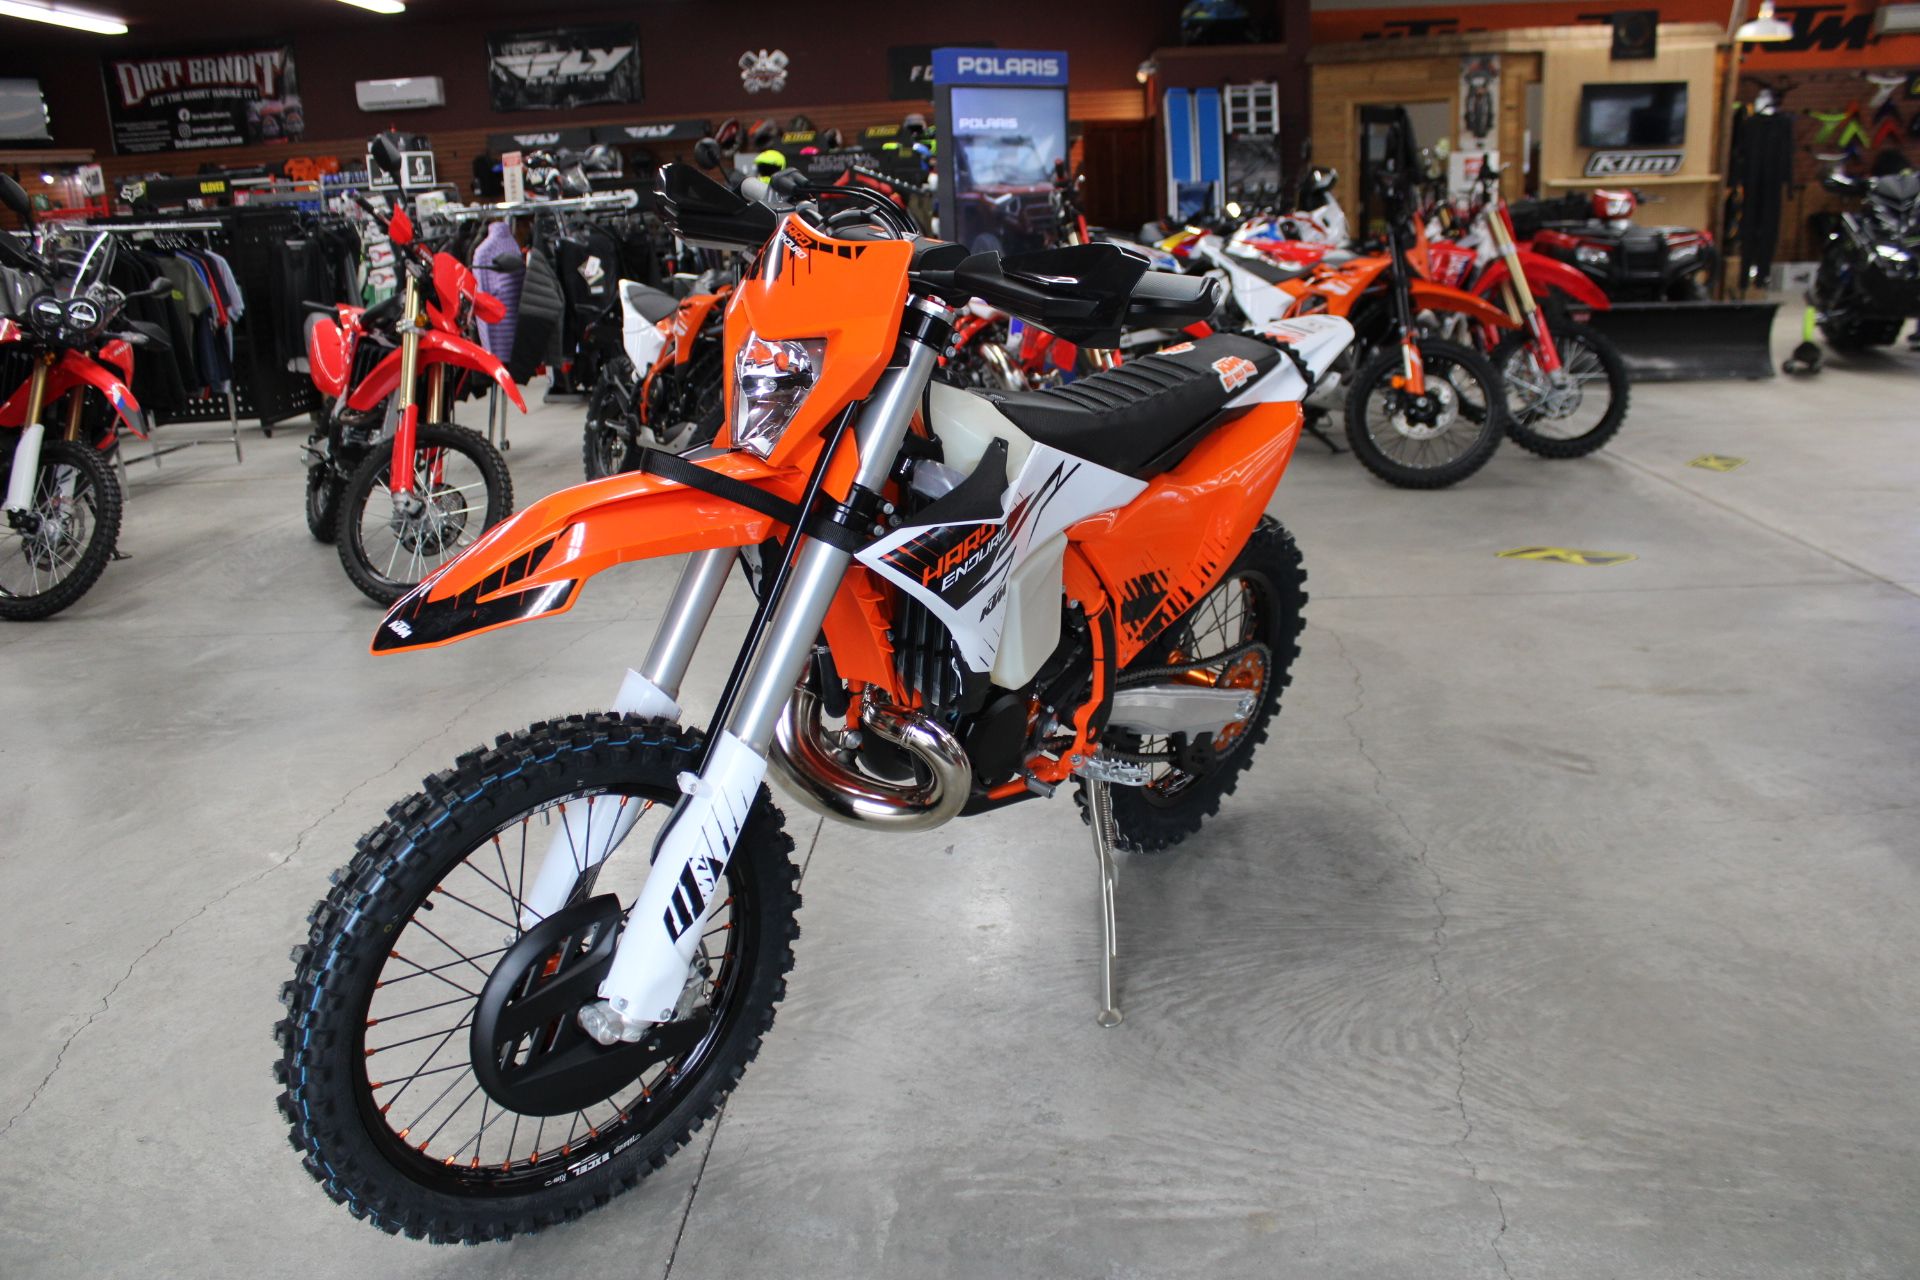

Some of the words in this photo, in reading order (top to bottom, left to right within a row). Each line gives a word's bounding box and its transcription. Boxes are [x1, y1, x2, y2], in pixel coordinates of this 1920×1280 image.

[494, 46, 633, 79] FLY
[957, 56, 1059, 76] POLARIS
[116, 60, 183, 105] DIRT
[187, 51, 282, 96] BANDIT
[624, 124, 676, 138] FLY
[959, 117, 1018, 130] POLARIS
[513, 133, 560, 146] FLY
[922, 524, 996, 588] HARD
[941, 524, 1008, 592] ENDURO
[388, 620, 413, 638] KTM
[532, 793, 577, 814] EXCEL
[572, 1151, 610, 1177] EXCEL
